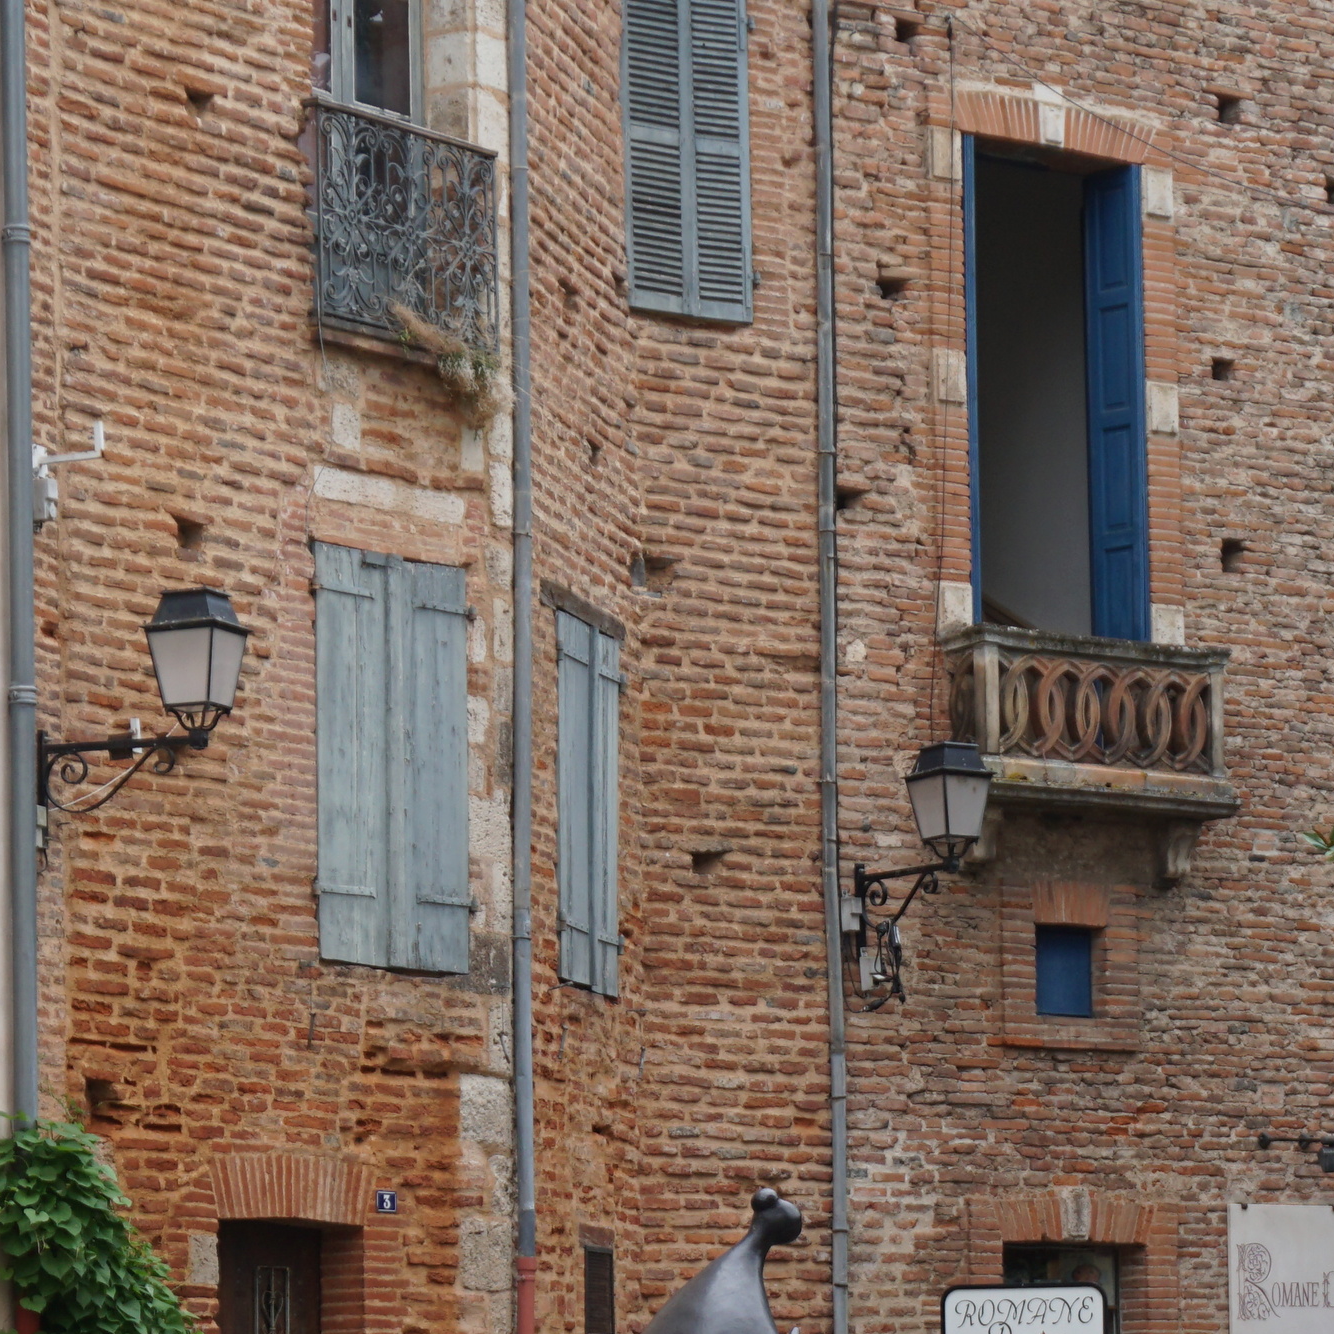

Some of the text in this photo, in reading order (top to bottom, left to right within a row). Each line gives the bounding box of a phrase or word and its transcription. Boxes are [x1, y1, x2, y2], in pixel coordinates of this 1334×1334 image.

[383, 1194, 391, 1209] 3
[1236, 1242, 1320, 1321] ROMANE
[954, 1296, 1094, 1328] ROMANE
